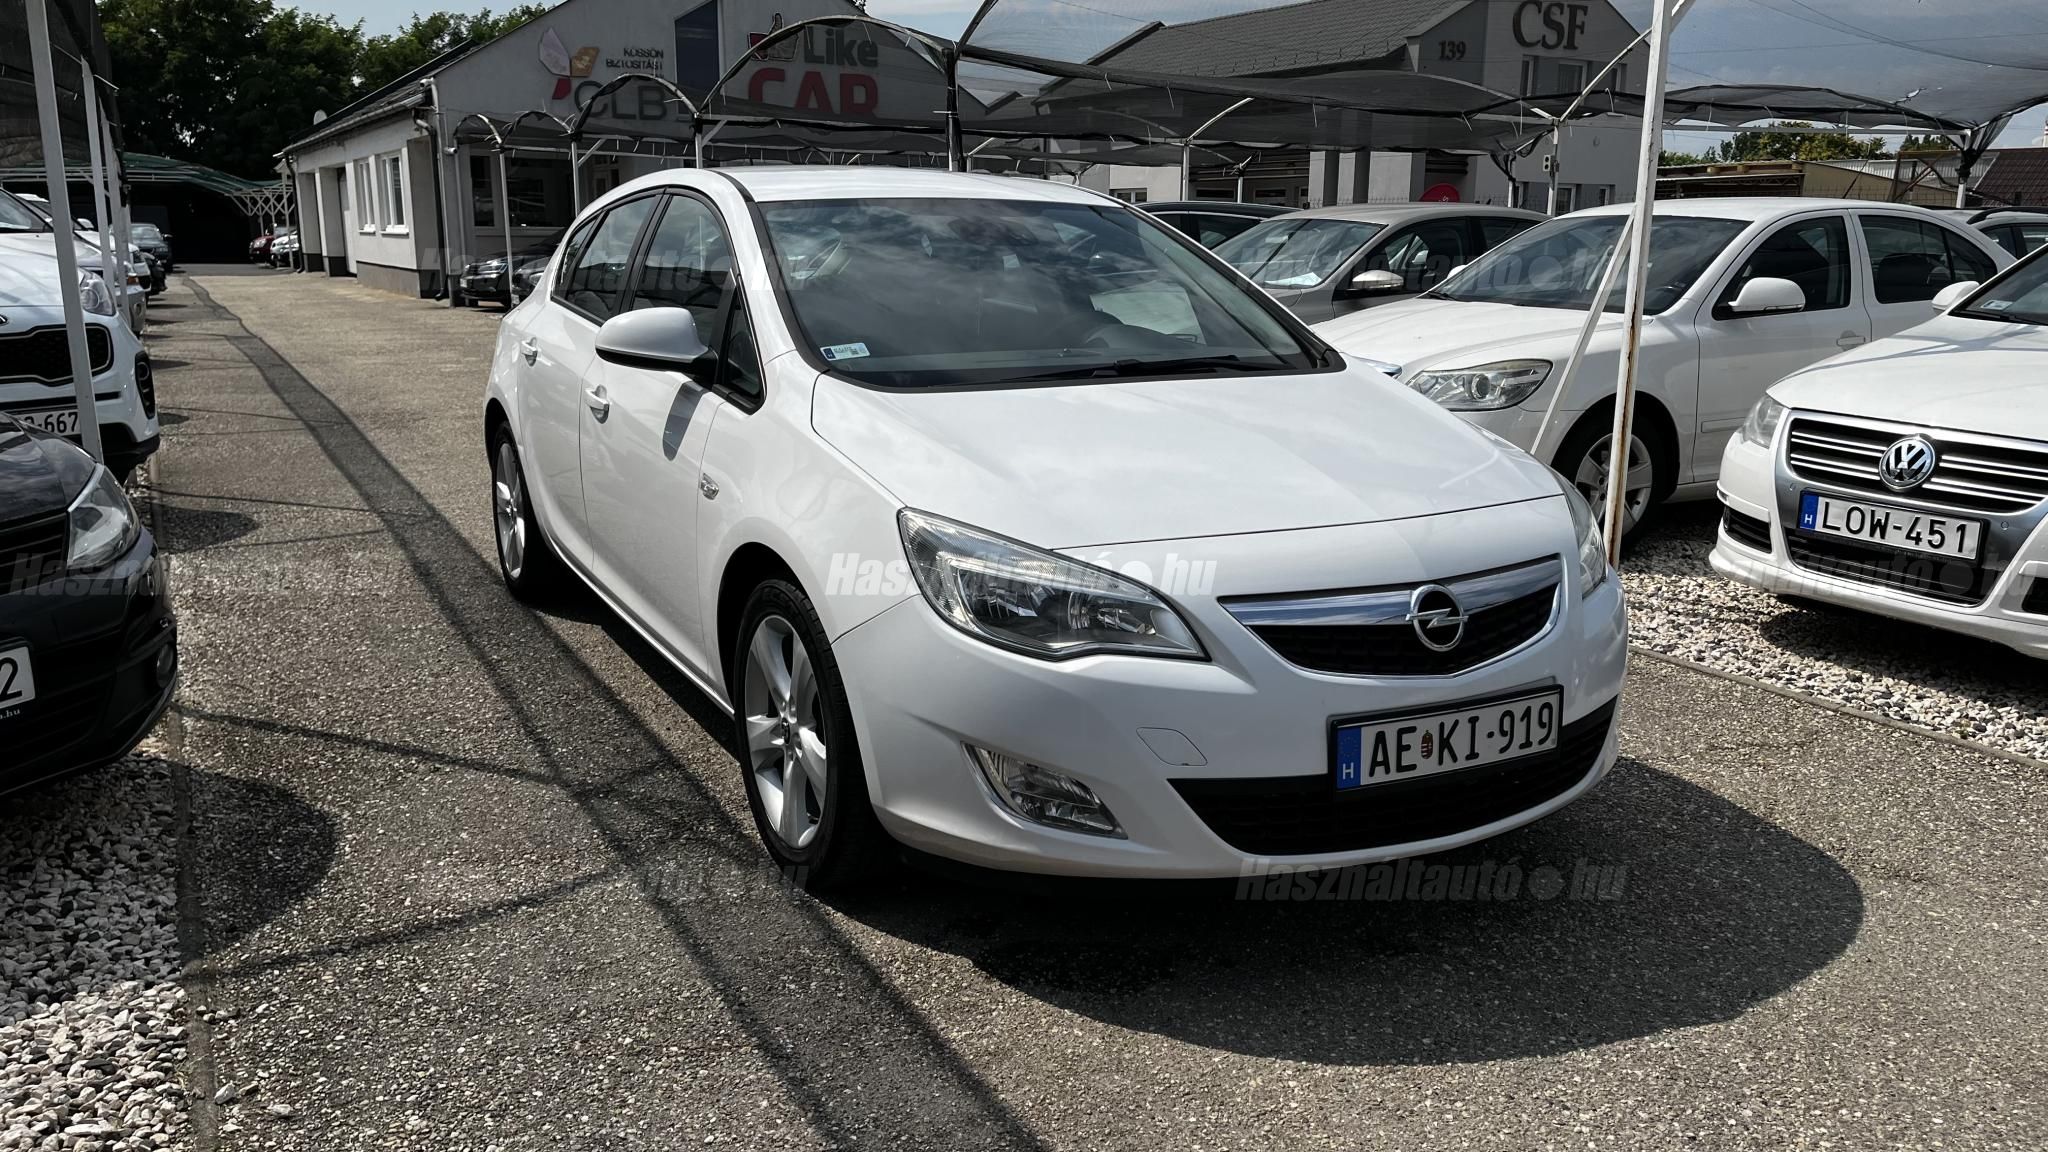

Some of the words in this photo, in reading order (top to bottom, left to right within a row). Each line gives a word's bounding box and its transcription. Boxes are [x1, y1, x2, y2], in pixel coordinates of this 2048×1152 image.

[1512, 0, 1588, 50] CSF
[803, 25, 879, 67] Like
[1438, 40, 1466, 61] 139
[1804, 513, 1813, 525] H
[1822, 501, 1968, 553] LOW-451
[1342, 762, 1354, 780] H
